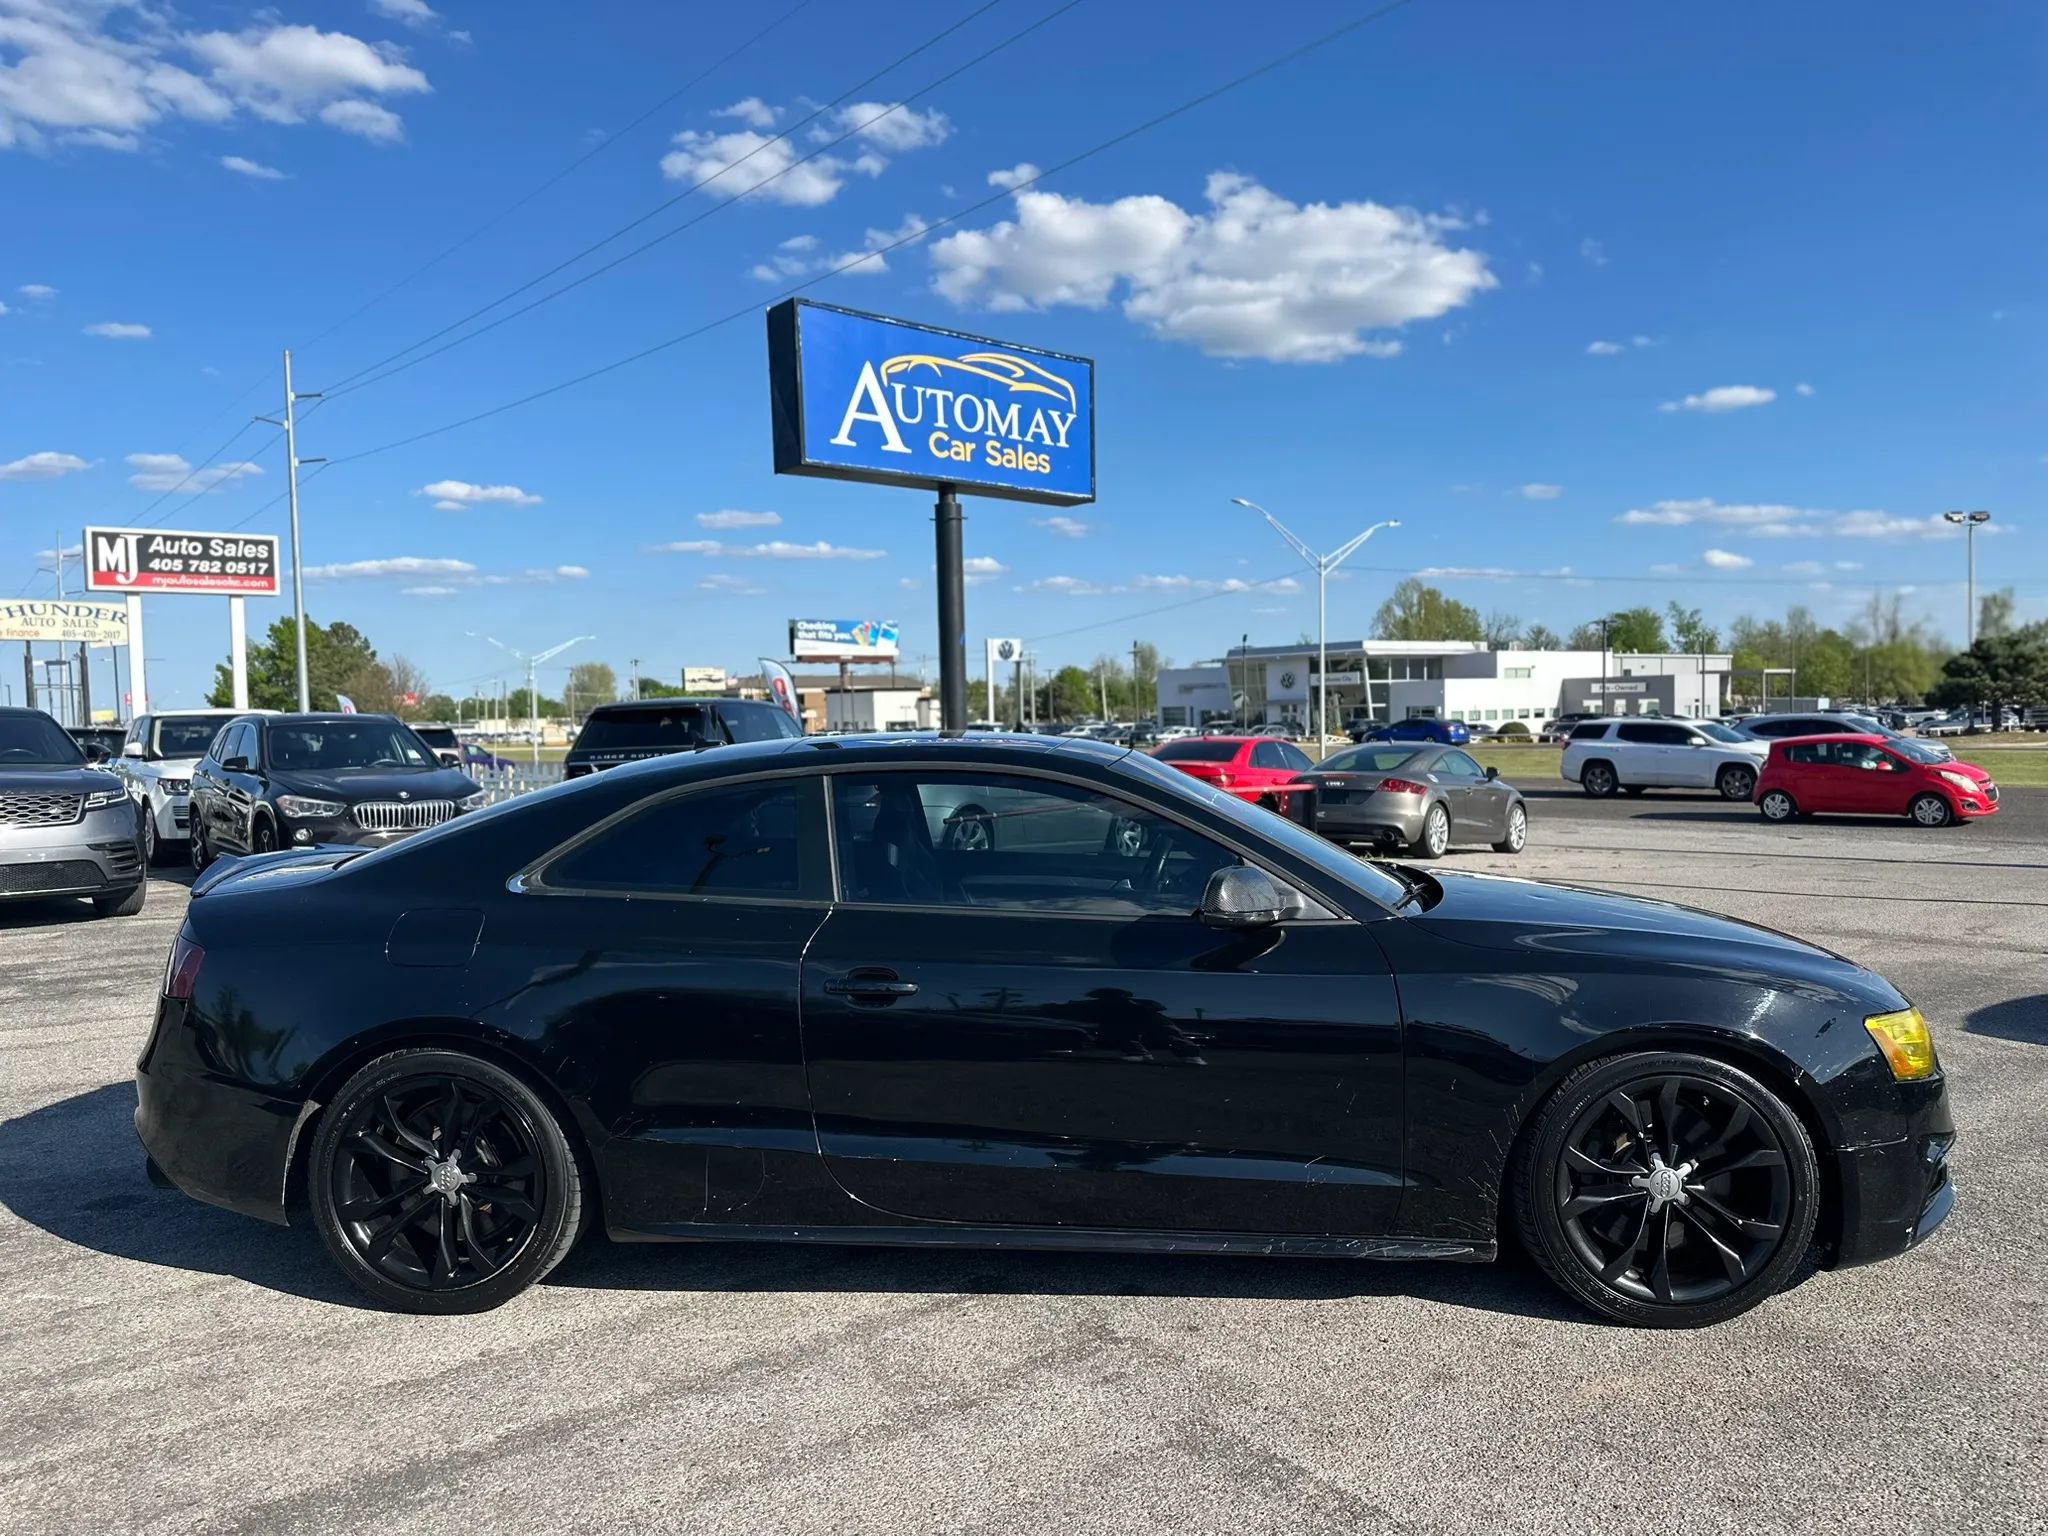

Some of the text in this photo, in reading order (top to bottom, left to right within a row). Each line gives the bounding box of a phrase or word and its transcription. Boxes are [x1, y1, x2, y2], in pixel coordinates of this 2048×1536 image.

[830, 360, 1077, 454] AUTOMAY
[928, 431, 1051, 474] Car Sales
[149, 536, 268, 558] Auto Sales
[97, 534, 143, 584] MJ
[149, 558, 268, 575] 405 782 0517
[0, 603, 127, 624] HUNDER
[21, 617, 99, 628] AUTO SALES
[6, 628, 40, 638] Finance
[797, 621, 837, 633] Checking
[798, 629, 817, 639] that
[818, 630, 833, 640] fits
